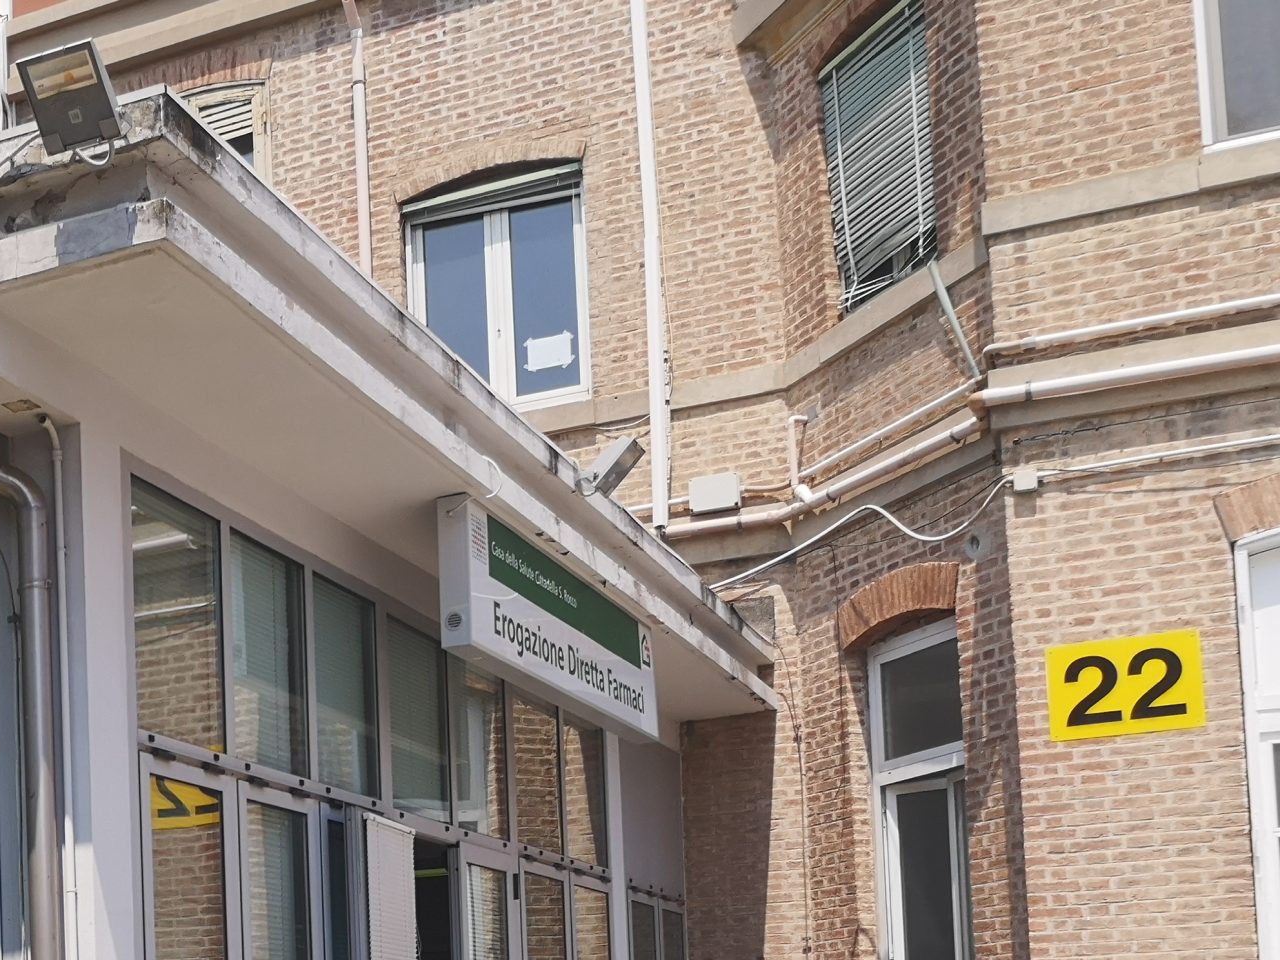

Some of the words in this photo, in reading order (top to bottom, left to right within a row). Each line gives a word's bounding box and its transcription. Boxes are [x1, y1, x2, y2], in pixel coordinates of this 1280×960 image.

[494, 600, 565, 671] Erogazione
[568, 644, 605, 694] Diretta
[607, 667, 645, 715] Farmaci
[1063, 647, 1189, 728] 22
